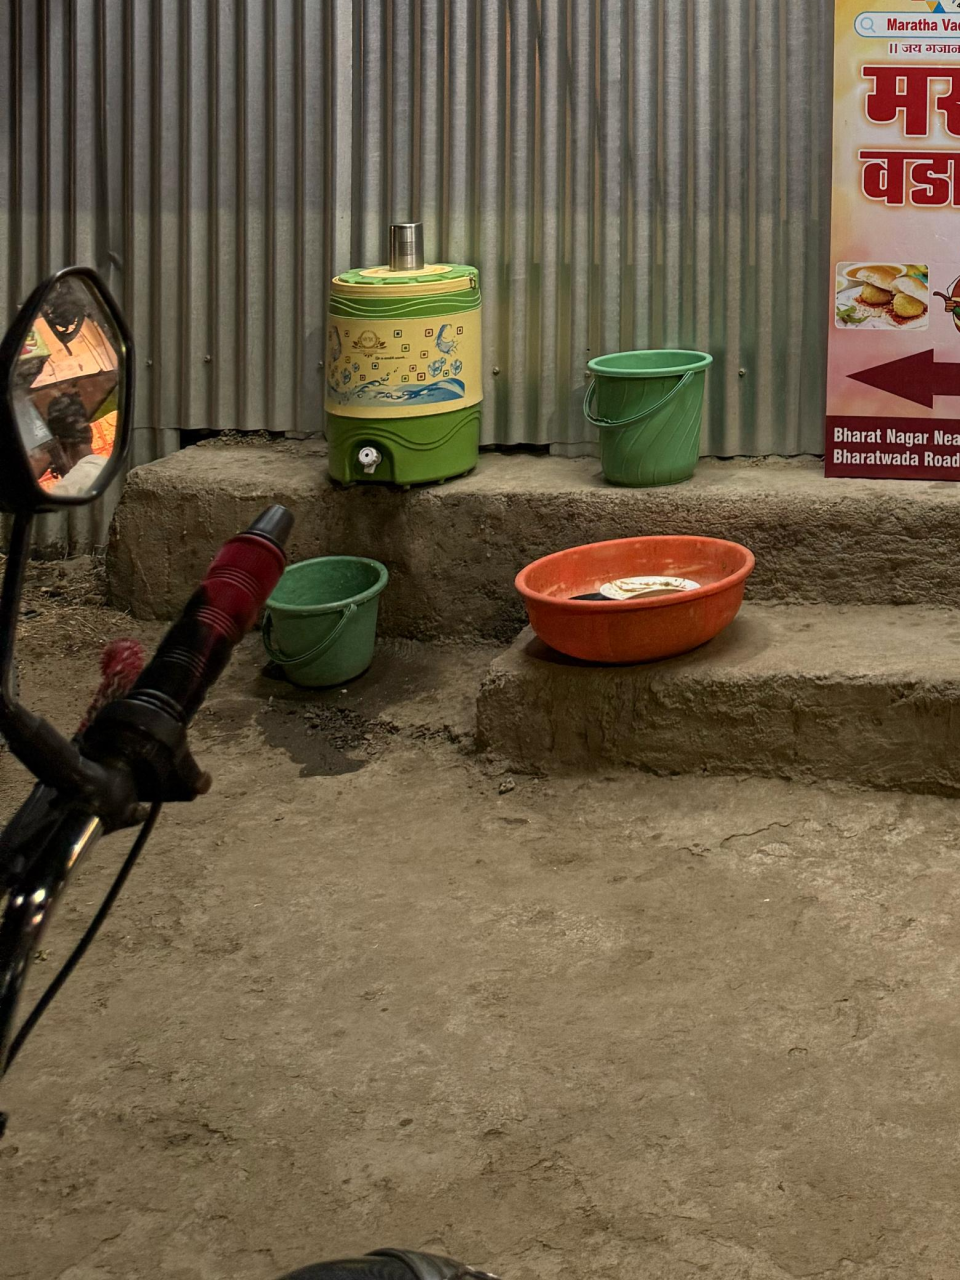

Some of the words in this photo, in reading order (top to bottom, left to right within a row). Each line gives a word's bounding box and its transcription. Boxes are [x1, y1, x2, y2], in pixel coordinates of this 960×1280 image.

[886, 17, 938, 31] Maratha
[901, 43, 922, 54] जय
[833, 427, 882, 444] Bharat
[886, 428, 929, 448] Nagar
[832, 449, 919, 467] Bharatwada
[923, 452, 960, 468] Road
